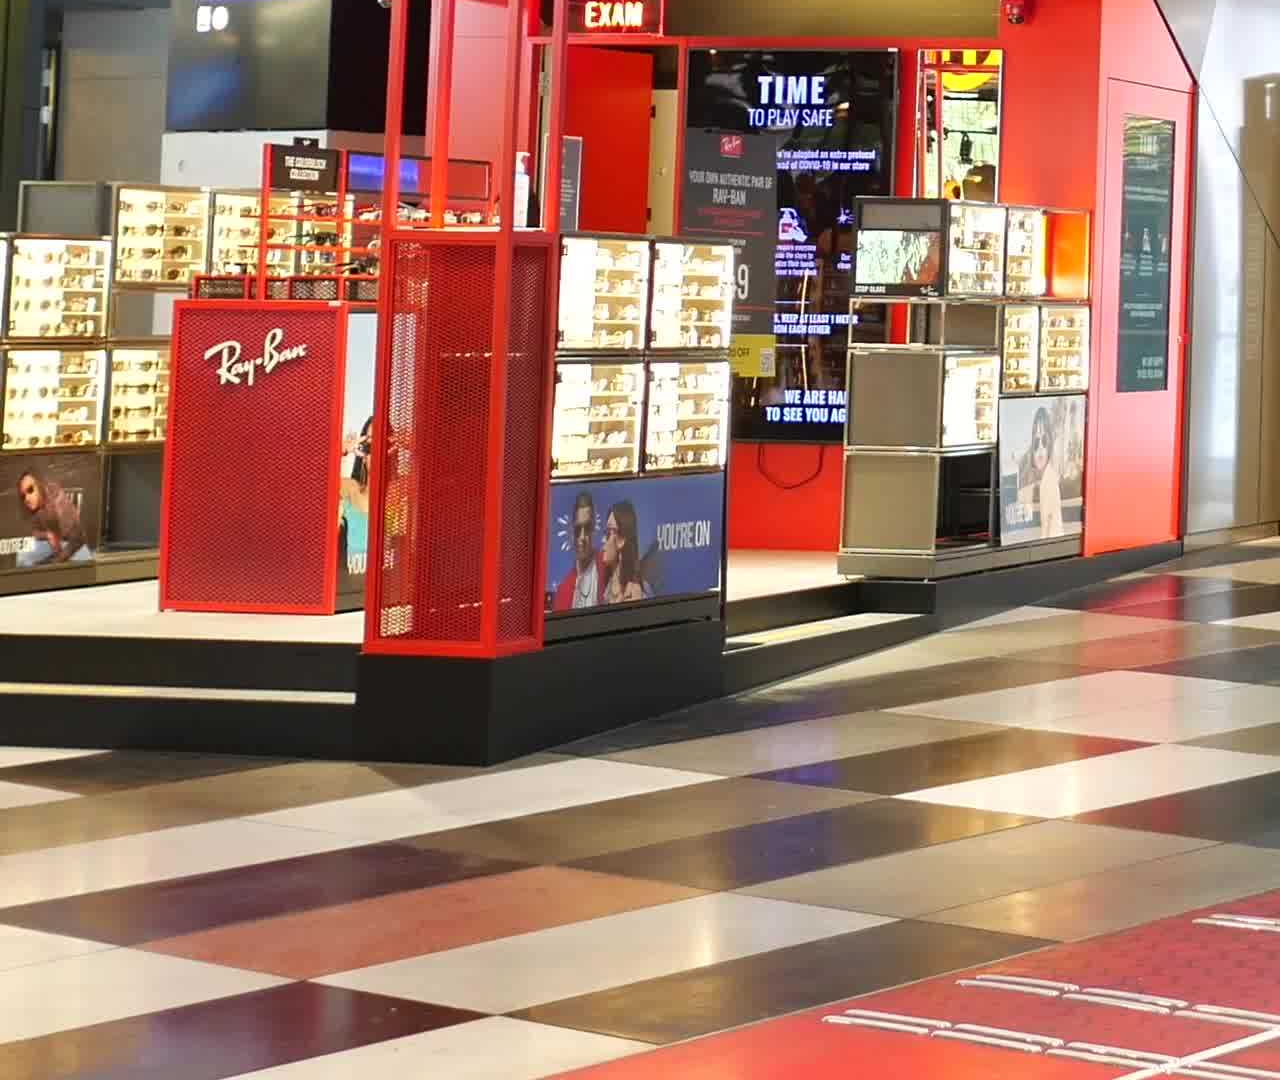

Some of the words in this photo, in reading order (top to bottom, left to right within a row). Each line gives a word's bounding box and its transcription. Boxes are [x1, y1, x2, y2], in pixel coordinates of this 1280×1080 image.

[584, 1, 644, 28] EXAM
[757, 75, 825, 105] TIME
[748, 108, 764, 127] TO
[767, 108, 800, 127] PLAY
[802, 108, 833, 127] SAFE
[799, 160, 831, 171] COVID-19
[712, 187, 747, 206] RAY-BAN
[784, 389, 801, 405] WE
[803, 389, 827, 405] ARE
[766, 406, 781, 422] TO
[783, 406, 803, 422] SEE
[804, 406, 828, 422] YOU
[830, 407, 847, 423] AG
[656, 521, 693, 551] YOU'RE
[694, 519, 711, 548] ON
